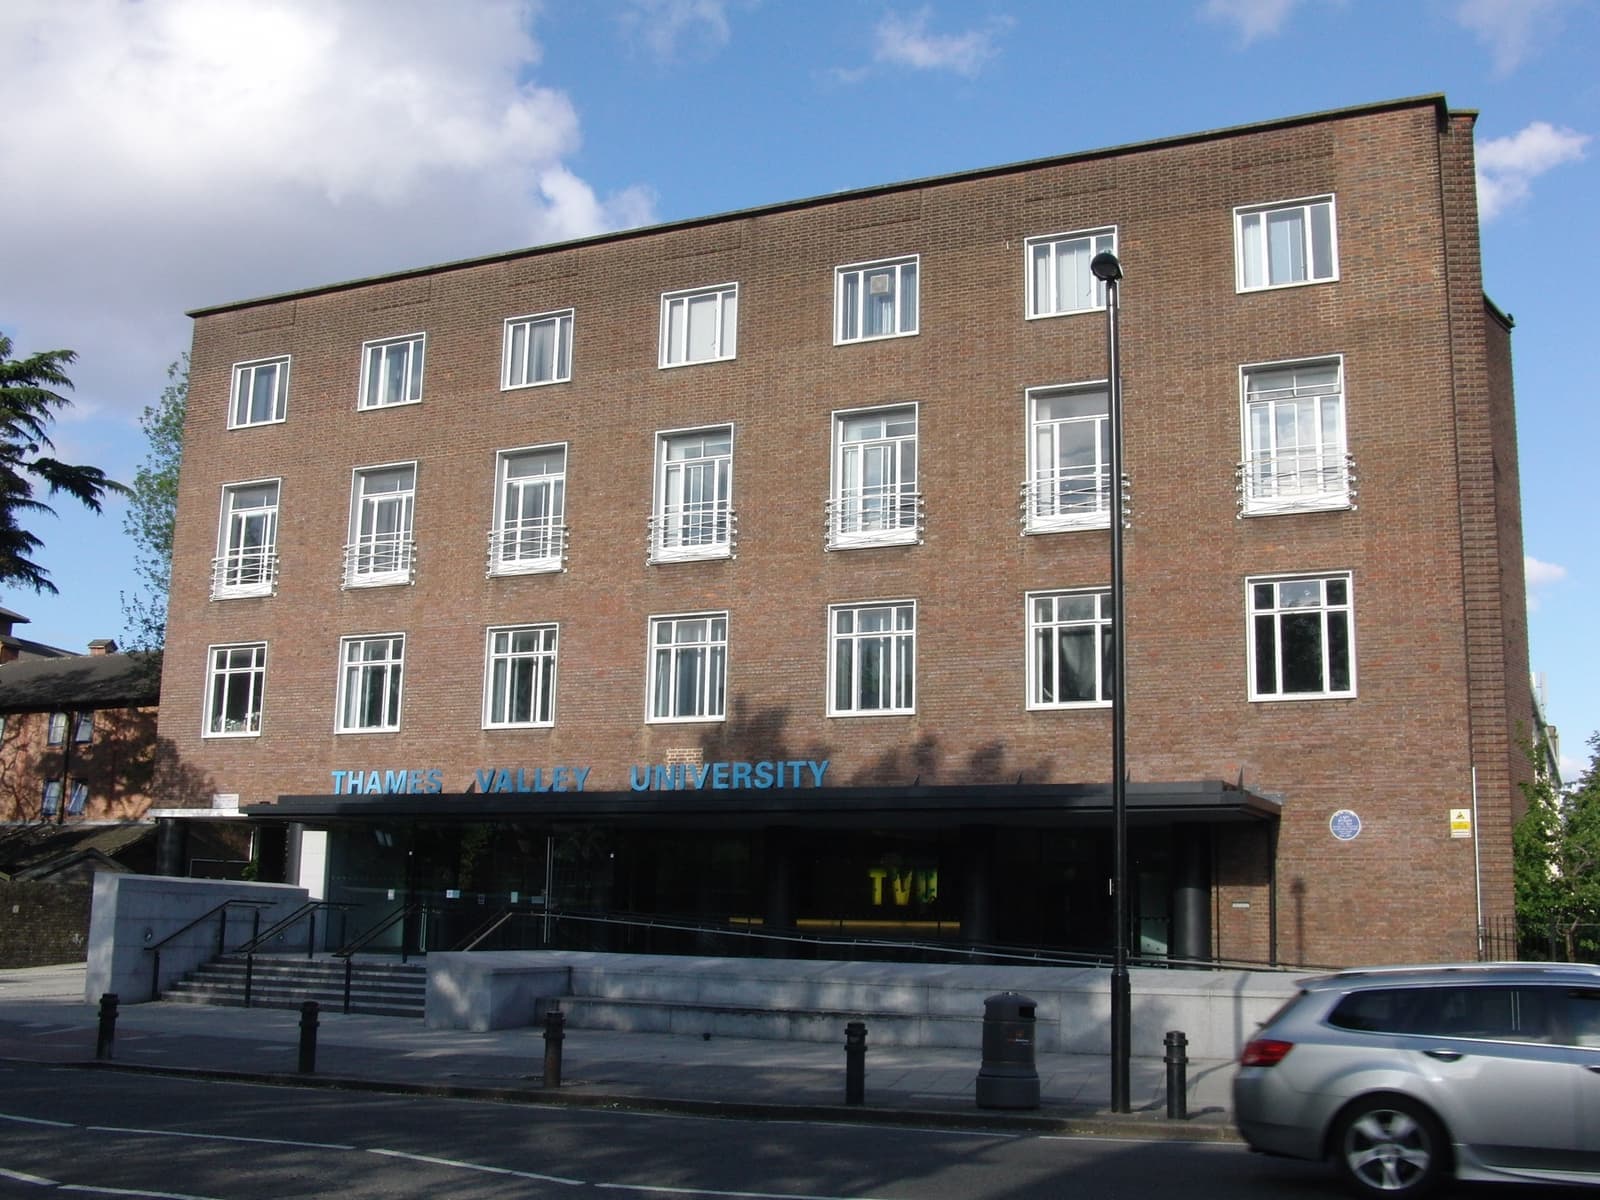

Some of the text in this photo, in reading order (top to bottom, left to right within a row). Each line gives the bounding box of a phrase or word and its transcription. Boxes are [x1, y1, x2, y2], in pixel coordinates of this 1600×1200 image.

[331, 760, 829, 795] THAMES VALLEY UNIVERSITY
[869, 869, 938, 905] TVU
